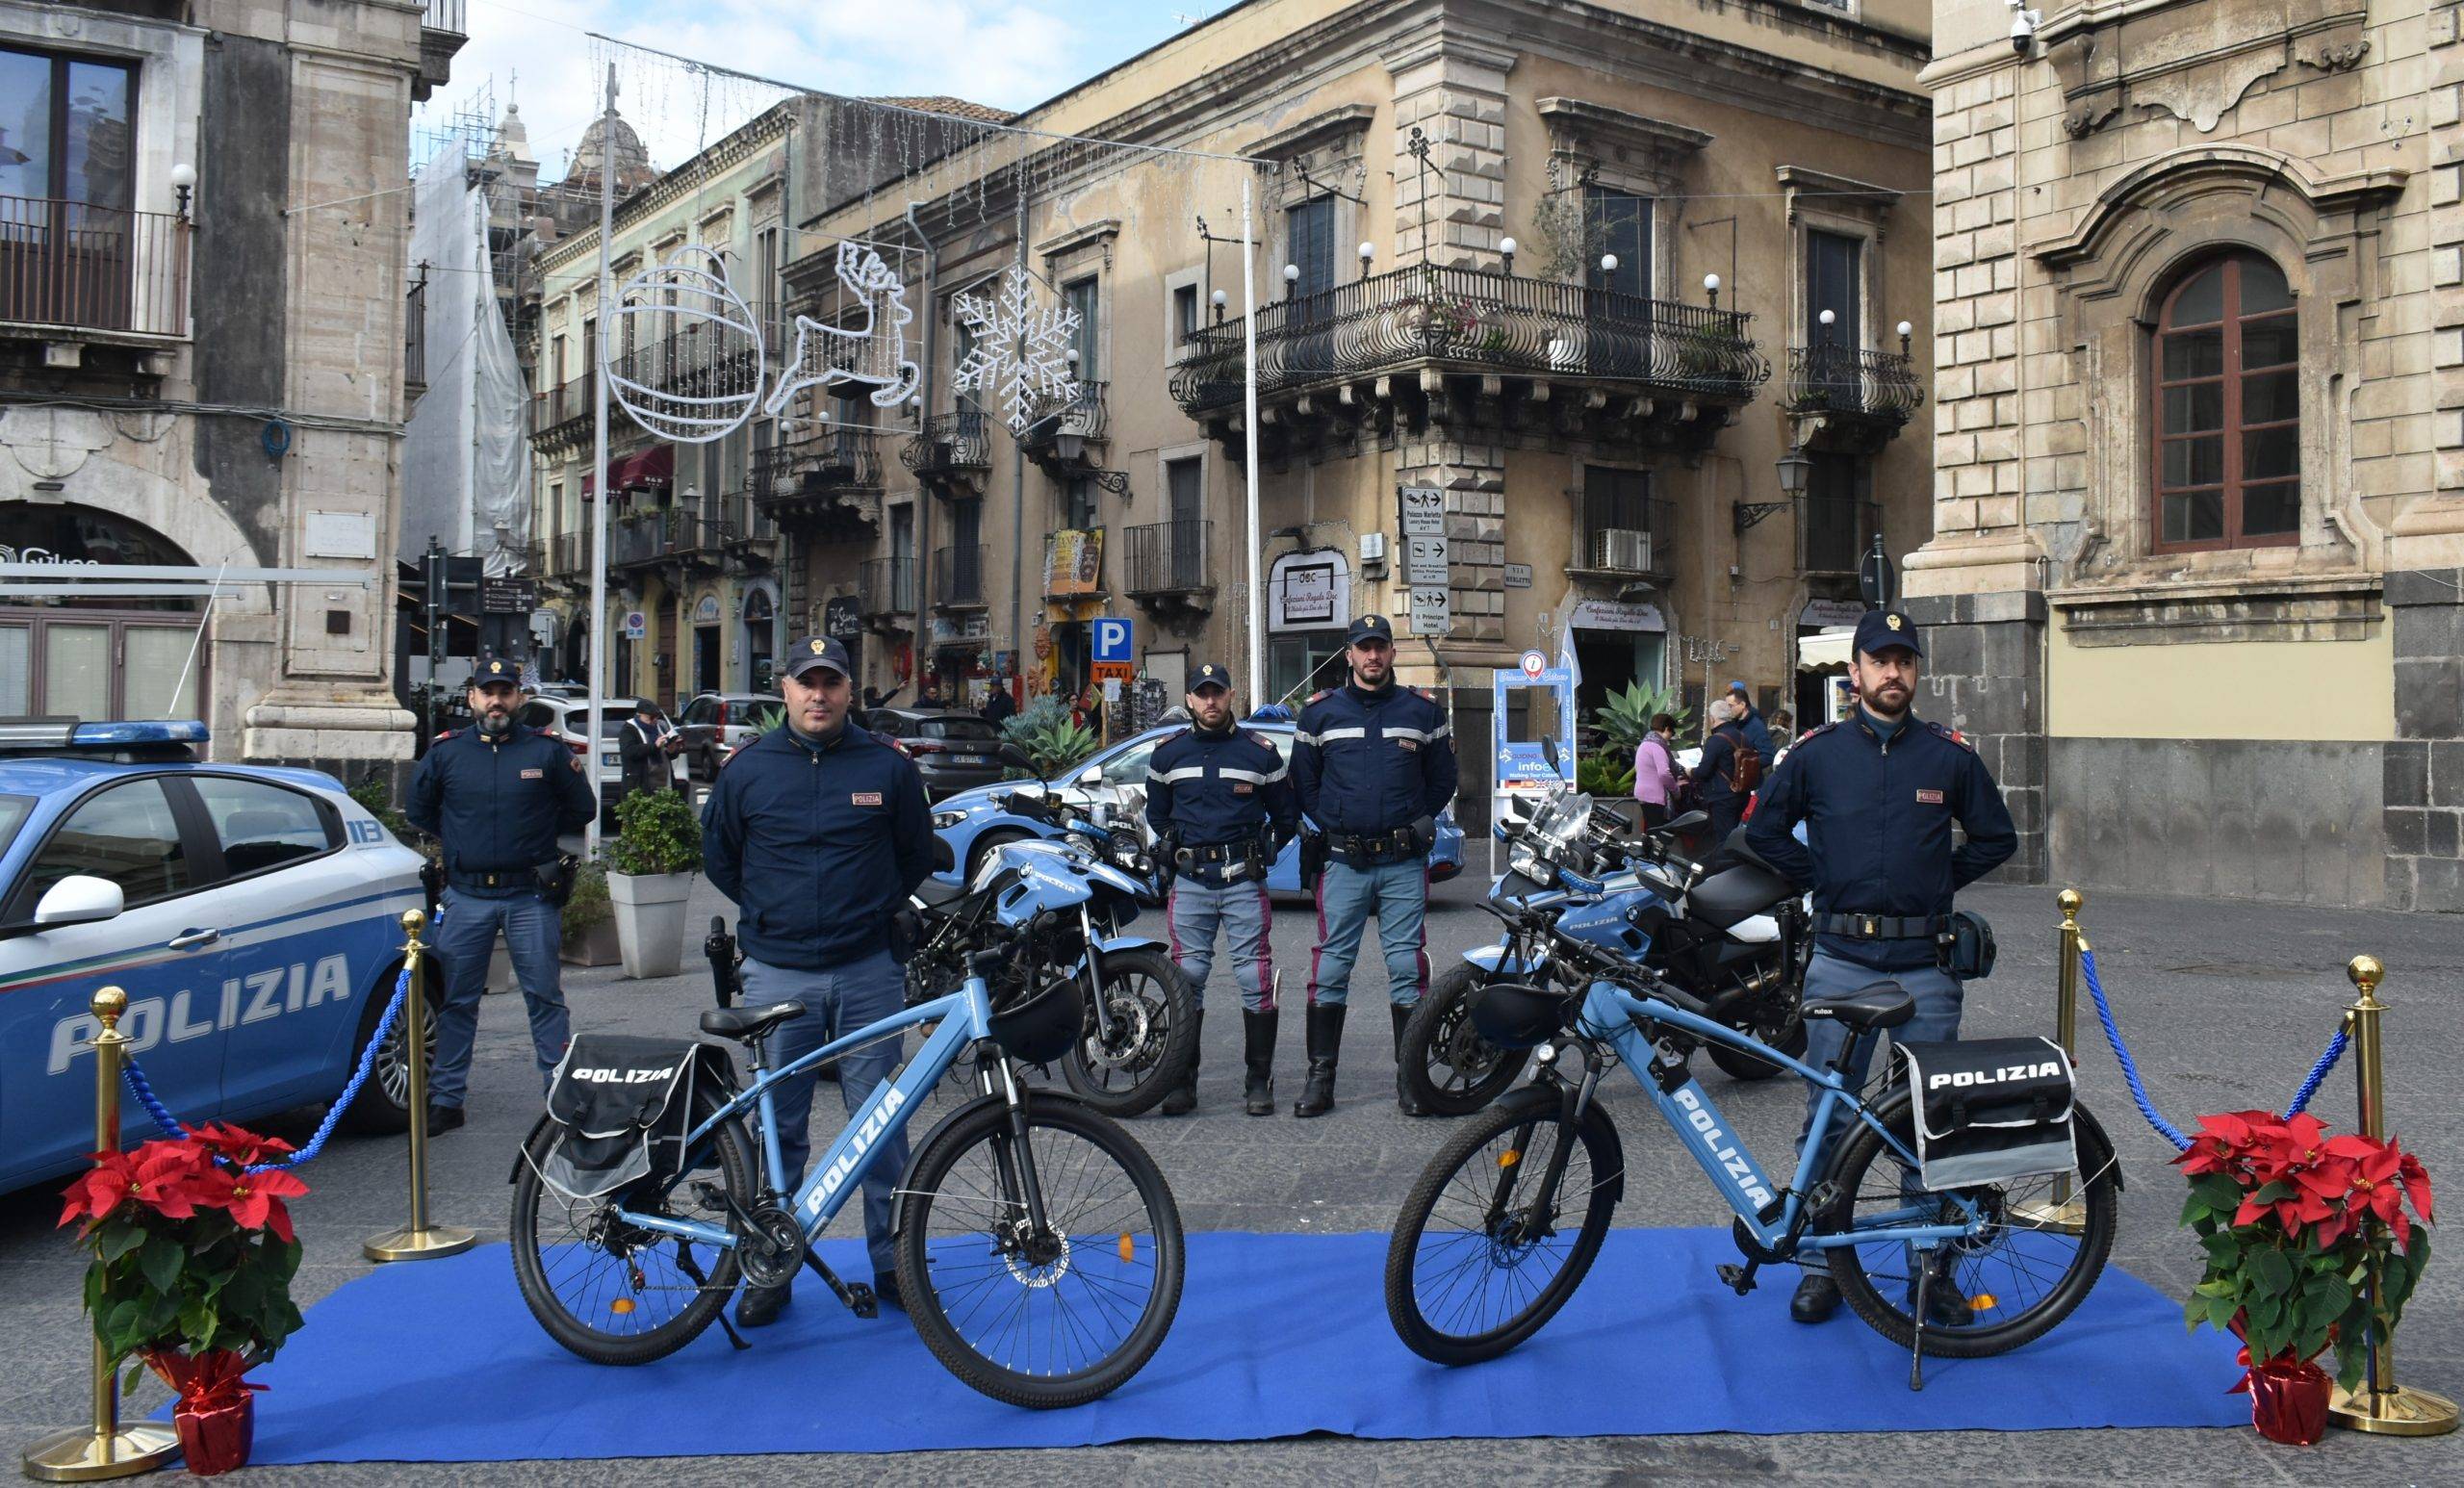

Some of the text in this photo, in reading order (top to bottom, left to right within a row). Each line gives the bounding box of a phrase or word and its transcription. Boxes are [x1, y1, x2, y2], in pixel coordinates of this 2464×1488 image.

[1101, 622, 1125, 656] P
[1095, 667, 1128, 679] TAXI
[854, 794, 880, 803] POLIZIA
[1917, 792, 1941, 801] POLIZIA
[346, 820, 384, 844] 113
[1035, 871, 1076, 894] POLIZIA
[1569, 916, 1618, 931] POLIZIA
[47, 953, 351, 1076] POLIZIA
[571, 1066, 674, 1084] POLIZIA
[1929, 1061, 2061, 1090] POLIZIA
[807, 1088, 906, 1216] POLIZIA
[1673, 1089, 1771, 1209] POLIZIA
